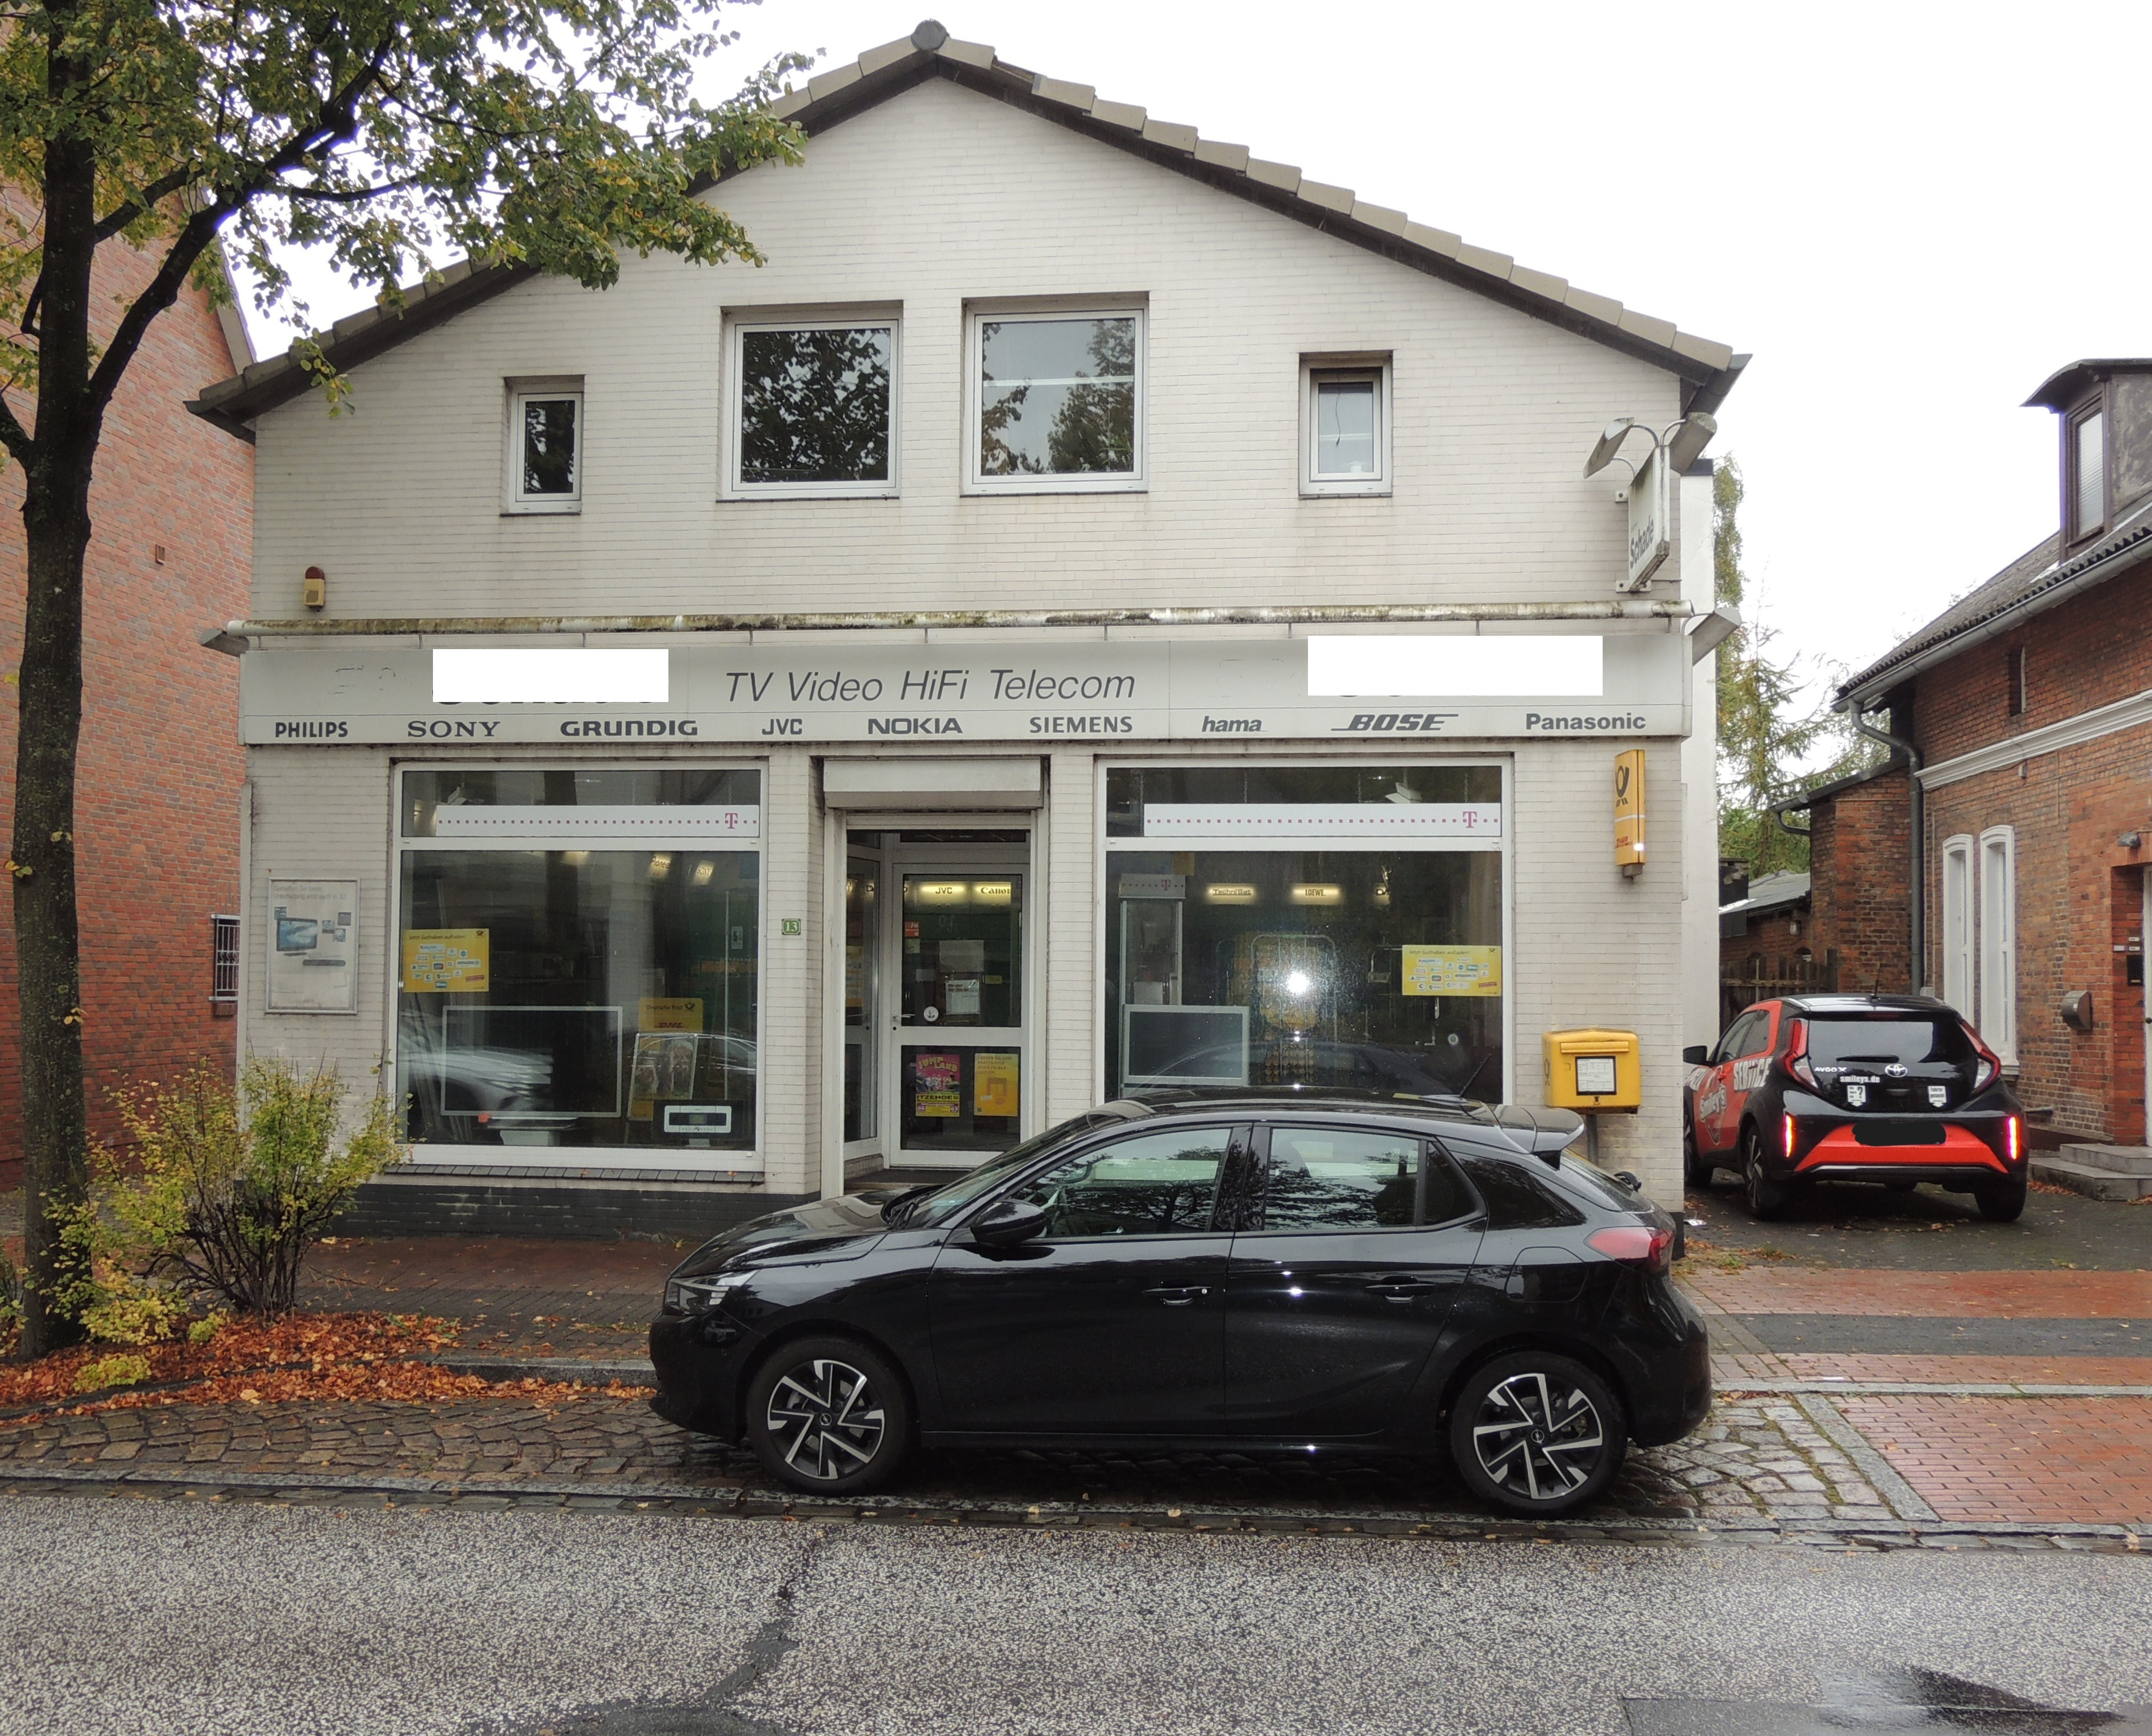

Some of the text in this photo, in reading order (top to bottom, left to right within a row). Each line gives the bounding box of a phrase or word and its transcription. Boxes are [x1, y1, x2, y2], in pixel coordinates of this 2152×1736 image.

[1630, 515, 1654, 569] Schade
[727, 669, 1135, 702] TV Video HiFi Telecom
[275, 721, 348, 738] PHILIPS
[408, 720, 501, 738] SONY
[560, 720, 698, 737] GRUNDIG
[761, 718, 802, 735] JVC
[868, 717, 963, 735] NOKIA
[1029, 716, 1133, 733] SIEMENS
[1201, 715, 1262, 732] hama
[1331, 714, 1459, 731] BOSE
[1526, 712, 1646, 730] Panasonic
[724, 812, 738, 829] T
[1462, 811, 1478, 828] T
[649, 856, 671, 869] Pionee
[935, 887, 953, 895] JVC
[785, 921, 798, 932] 13
[918, 1056, 943, 1069] JUMP
[934, 1062, 958, 1072] LAND
[1840, 1075, 1880, 1084] smileys.de
